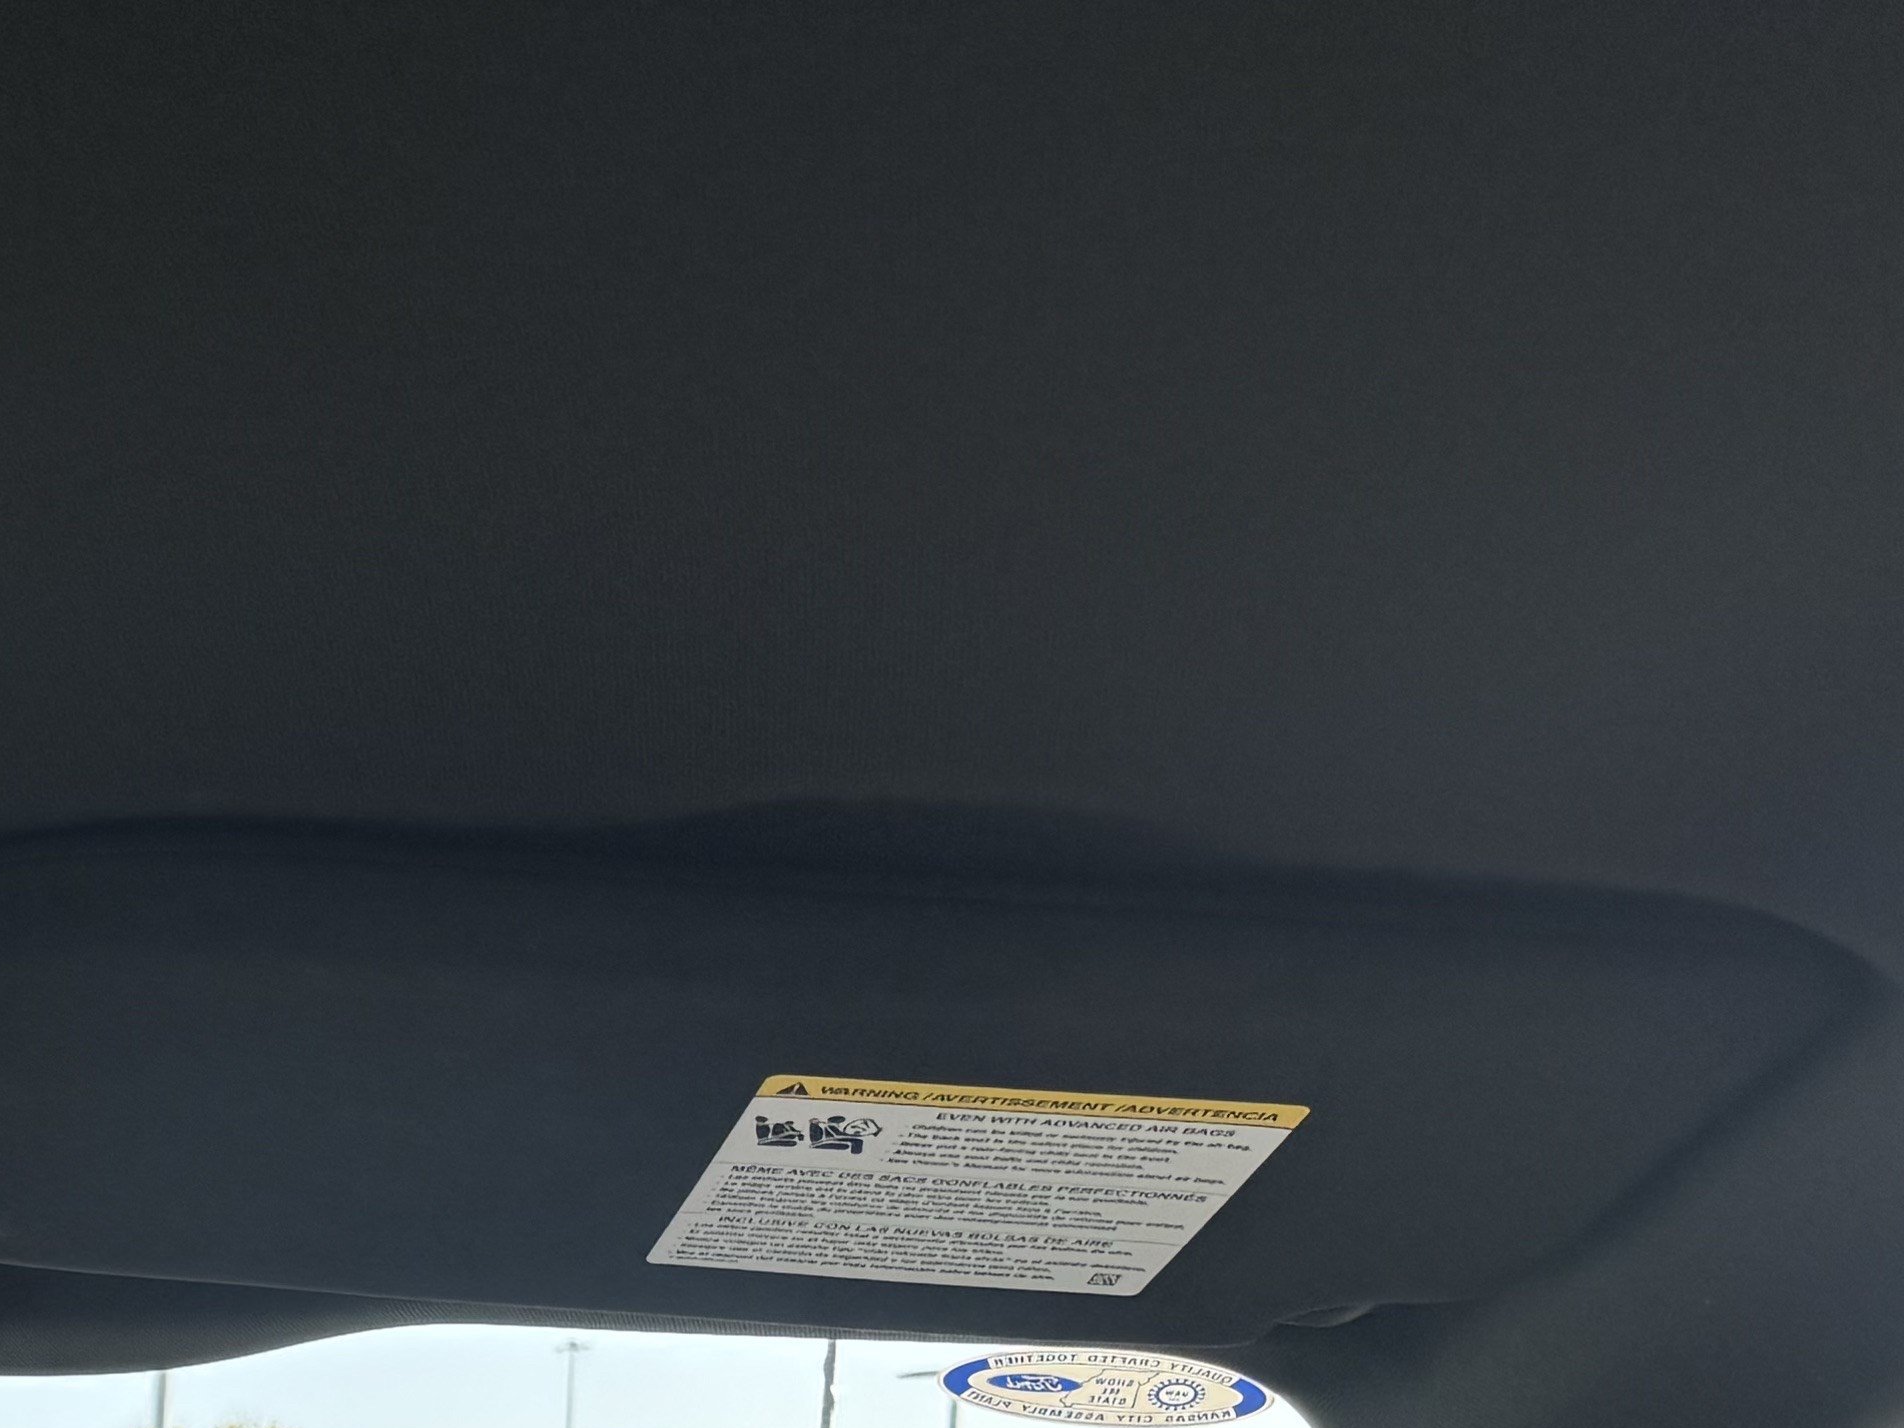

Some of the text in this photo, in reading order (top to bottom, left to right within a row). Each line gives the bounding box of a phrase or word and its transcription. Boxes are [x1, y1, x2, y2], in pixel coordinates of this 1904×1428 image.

[821, 1086, 920, 1100] WARNING
[936, 1112, 1236, 1138] EVEN WITH ADVANCED AIR BAGS
